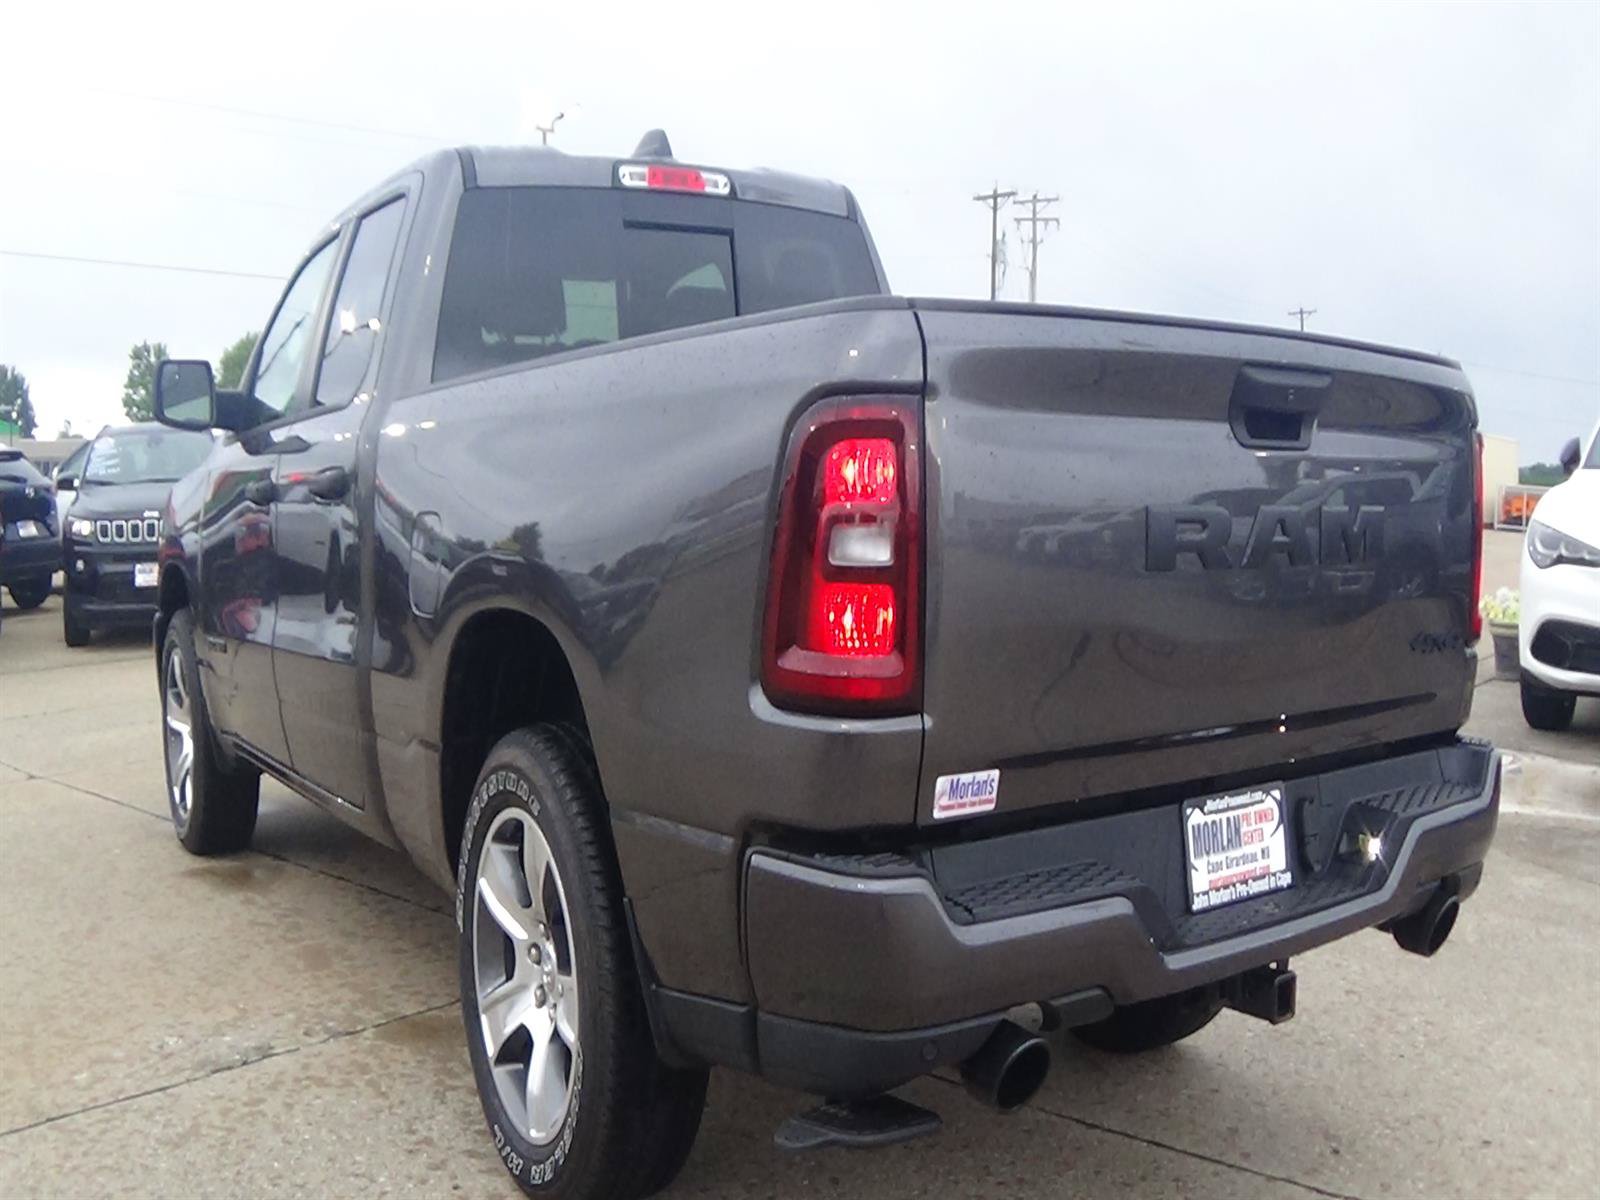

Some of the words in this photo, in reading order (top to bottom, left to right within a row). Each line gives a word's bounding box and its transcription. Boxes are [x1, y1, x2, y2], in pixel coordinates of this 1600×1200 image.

[1145, 504, 1385, 572] RAM
[948, 774, 995, 801] Morlan's
[1192, 815, 1242, 859] MORLAN
[1207, 859, 1223, 875] Cape
